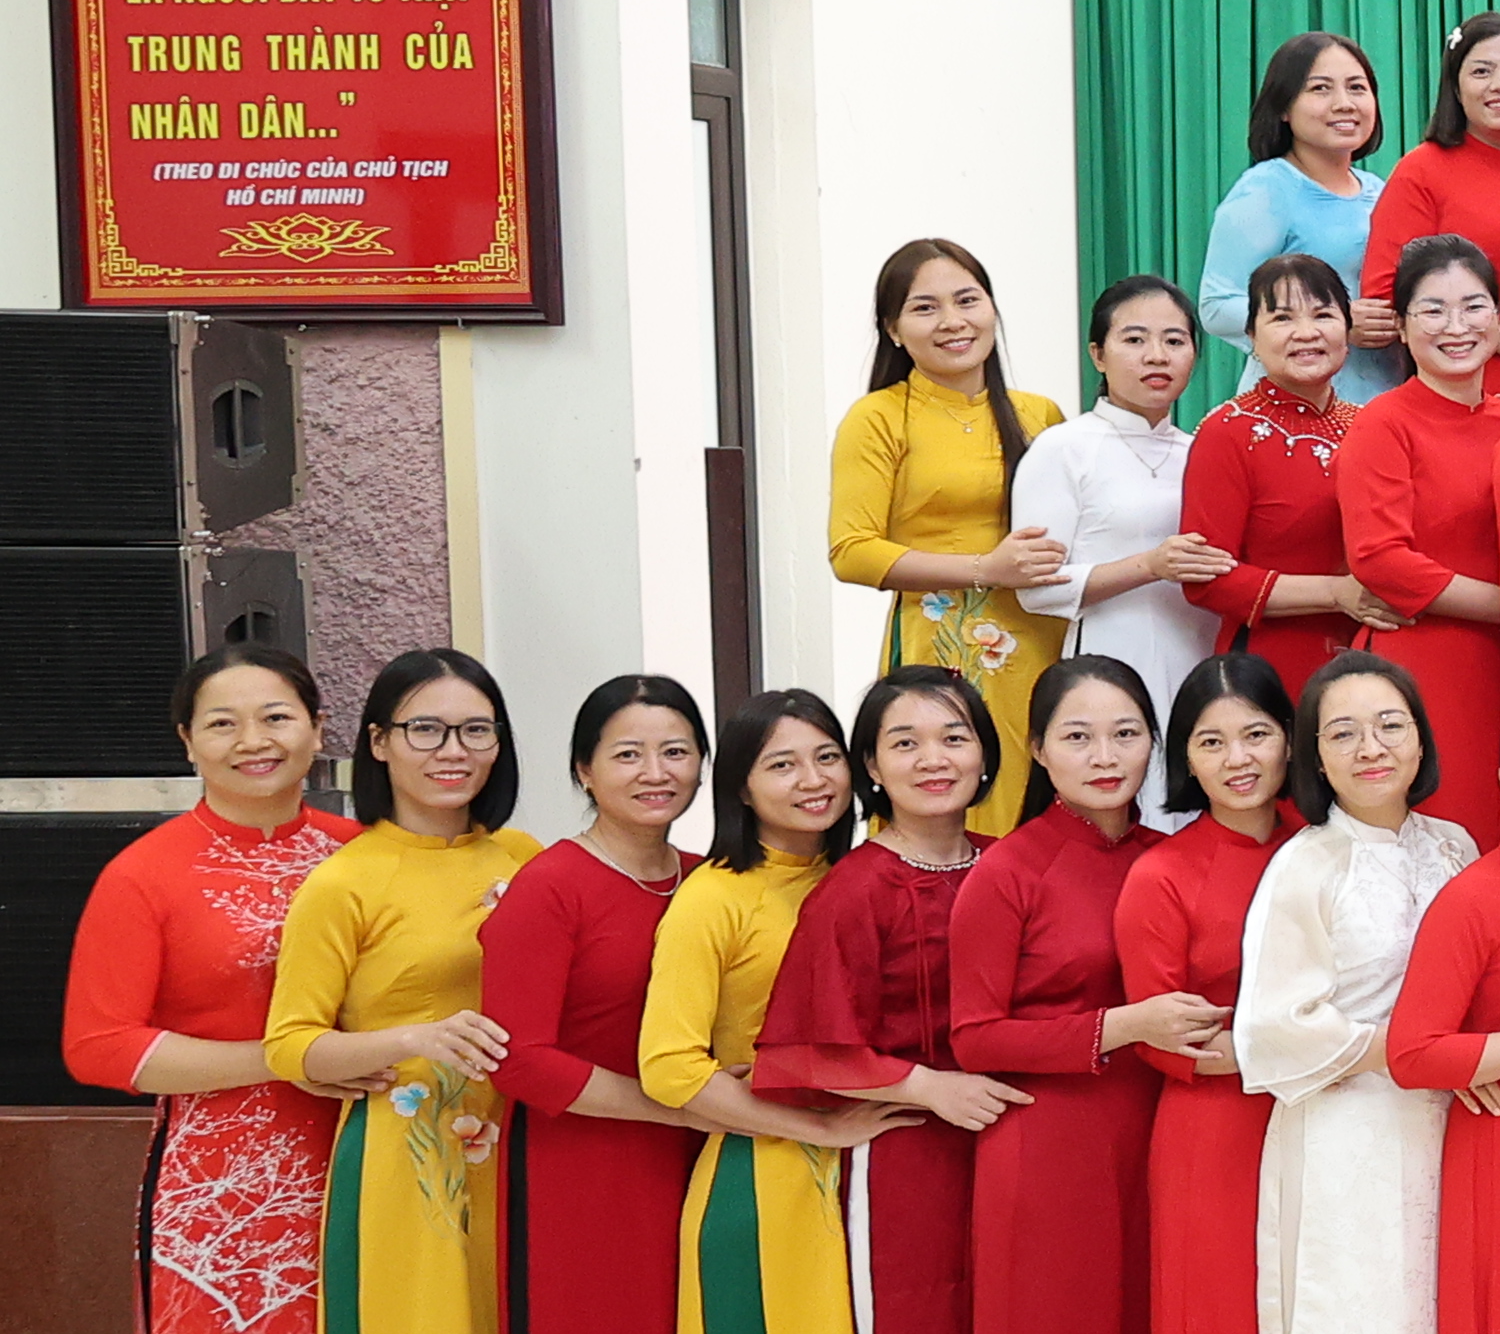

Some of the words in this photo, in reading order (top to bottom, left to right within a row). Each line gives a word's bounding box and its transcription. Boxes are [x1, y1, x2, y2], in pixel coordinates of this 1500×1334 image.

[127, 34, 241, 72] TRUNG
[266, 26, 379, 71] THÀNH
[406, 20, 473, 70] CỦA
[131, 95, 219, 140] NHÂN
[153, 162, 214, 181] (THEO
[218, 162, 241, 179] DI
[245, 158, 302, 179] CHÚC
[306, 156, 348, 178] CỦA
[353, 155, 397, 178] CHỦ
[402, 160, 449, 181] TỊCH
[260, 185, 297, 206] CHÍ
[300, 188, 365, 206] MINH)
